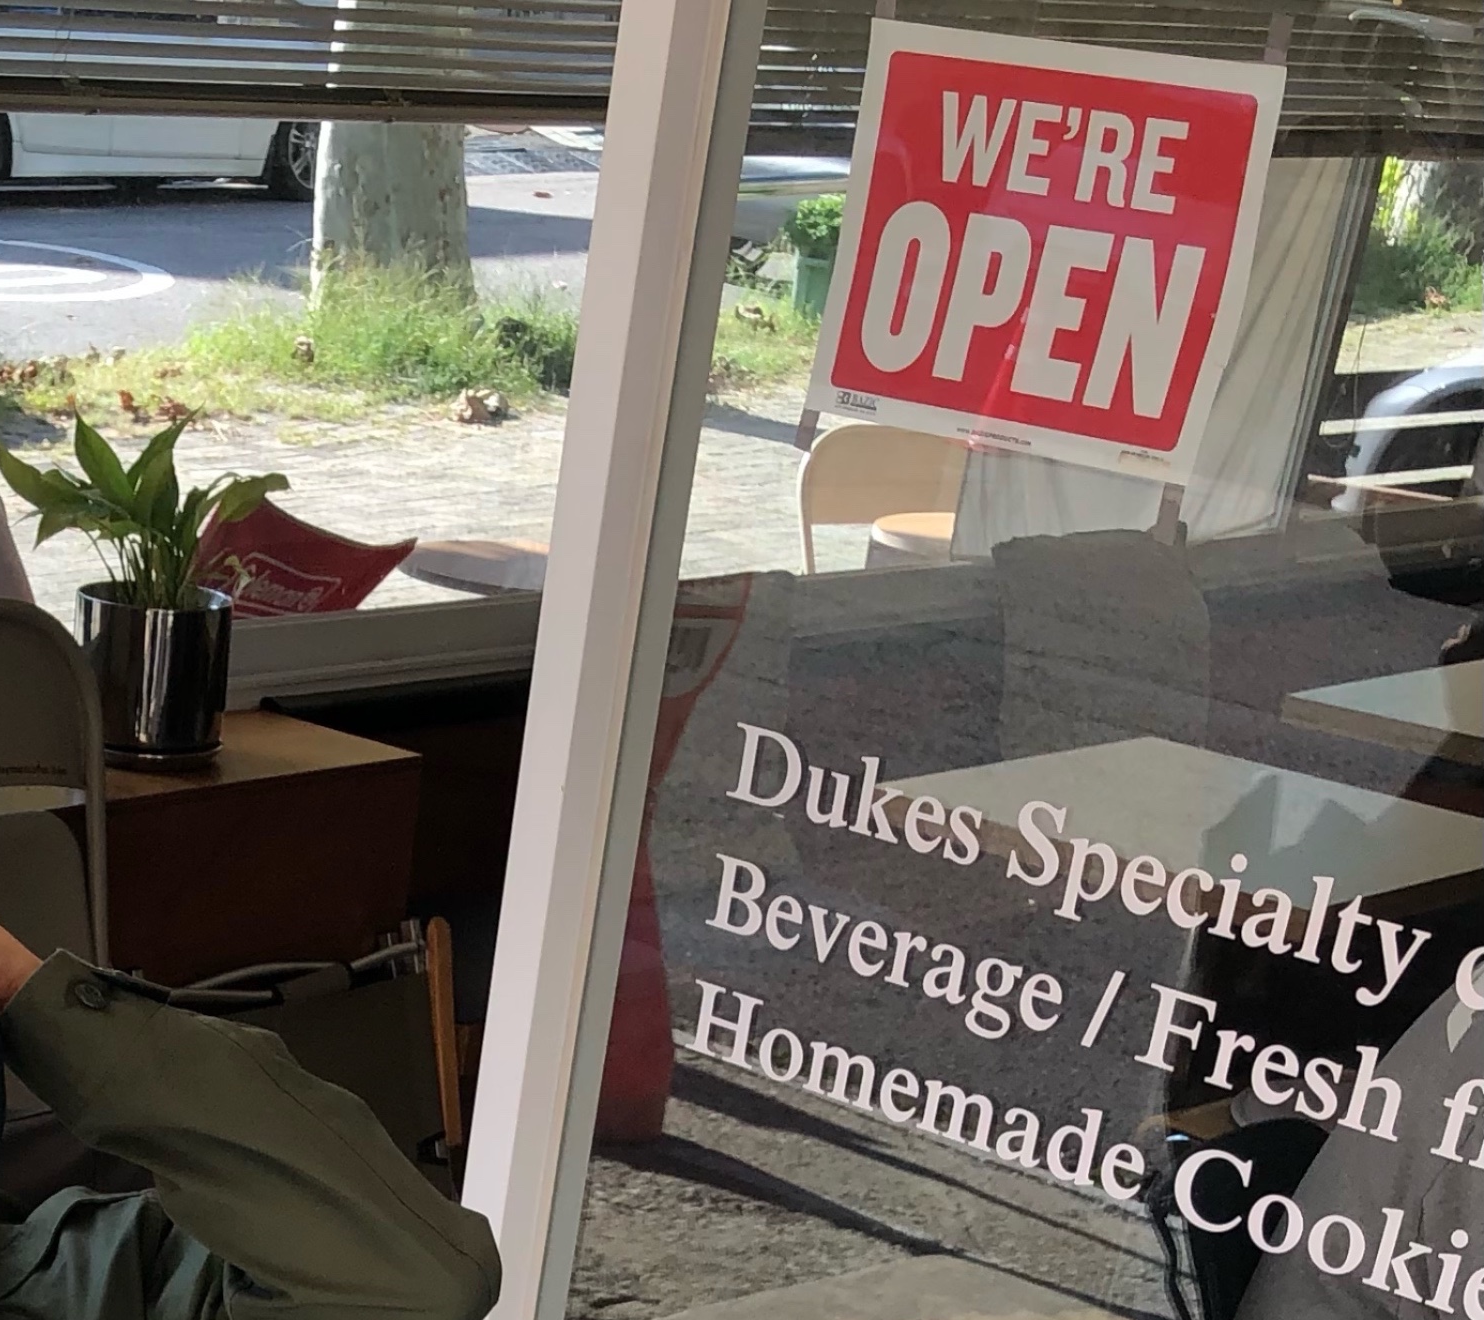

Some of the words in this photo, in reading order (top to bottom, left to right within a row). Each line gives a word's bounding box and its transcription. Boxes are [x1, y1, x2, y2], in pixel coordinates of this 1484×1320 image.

[861, 200, 1207, 420] OPEN
[726, 722, 982, 866] Dukes
[1006, 800, 1432, 1007] Specialty
[685, 979, 1145, 1200] Homemade
[704, 852, 1064, 1040] Beverage
[1080, 970, 1125, 1048] /
[1134, 982, 1403, 1143] Fresh
